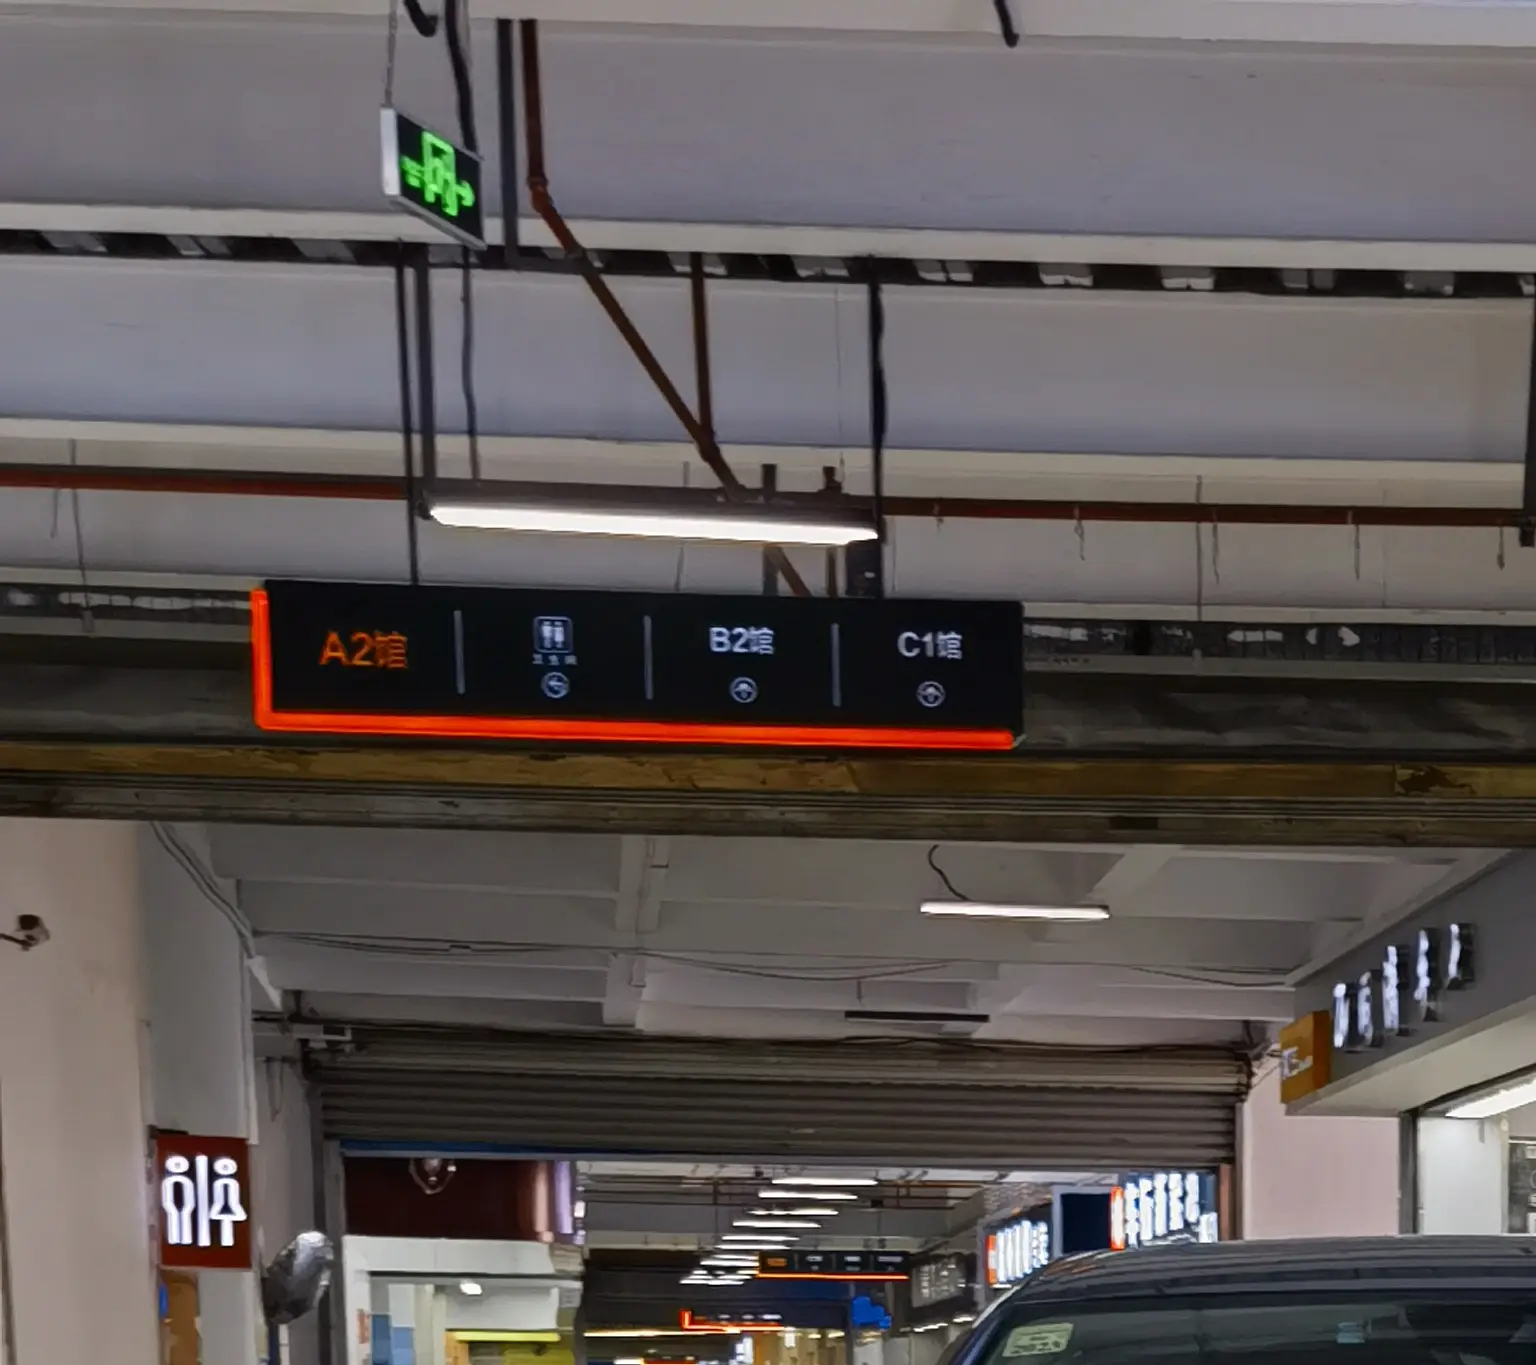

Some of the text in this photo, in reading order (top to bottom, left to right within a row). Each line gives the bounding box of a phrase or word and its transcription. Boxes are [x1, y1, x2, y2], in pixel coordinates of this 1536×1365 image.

[318, 629, 408, 668] A2馆
[709, 626, 775, 655] B2馆
[897, 631, 963, 659] C1馆
